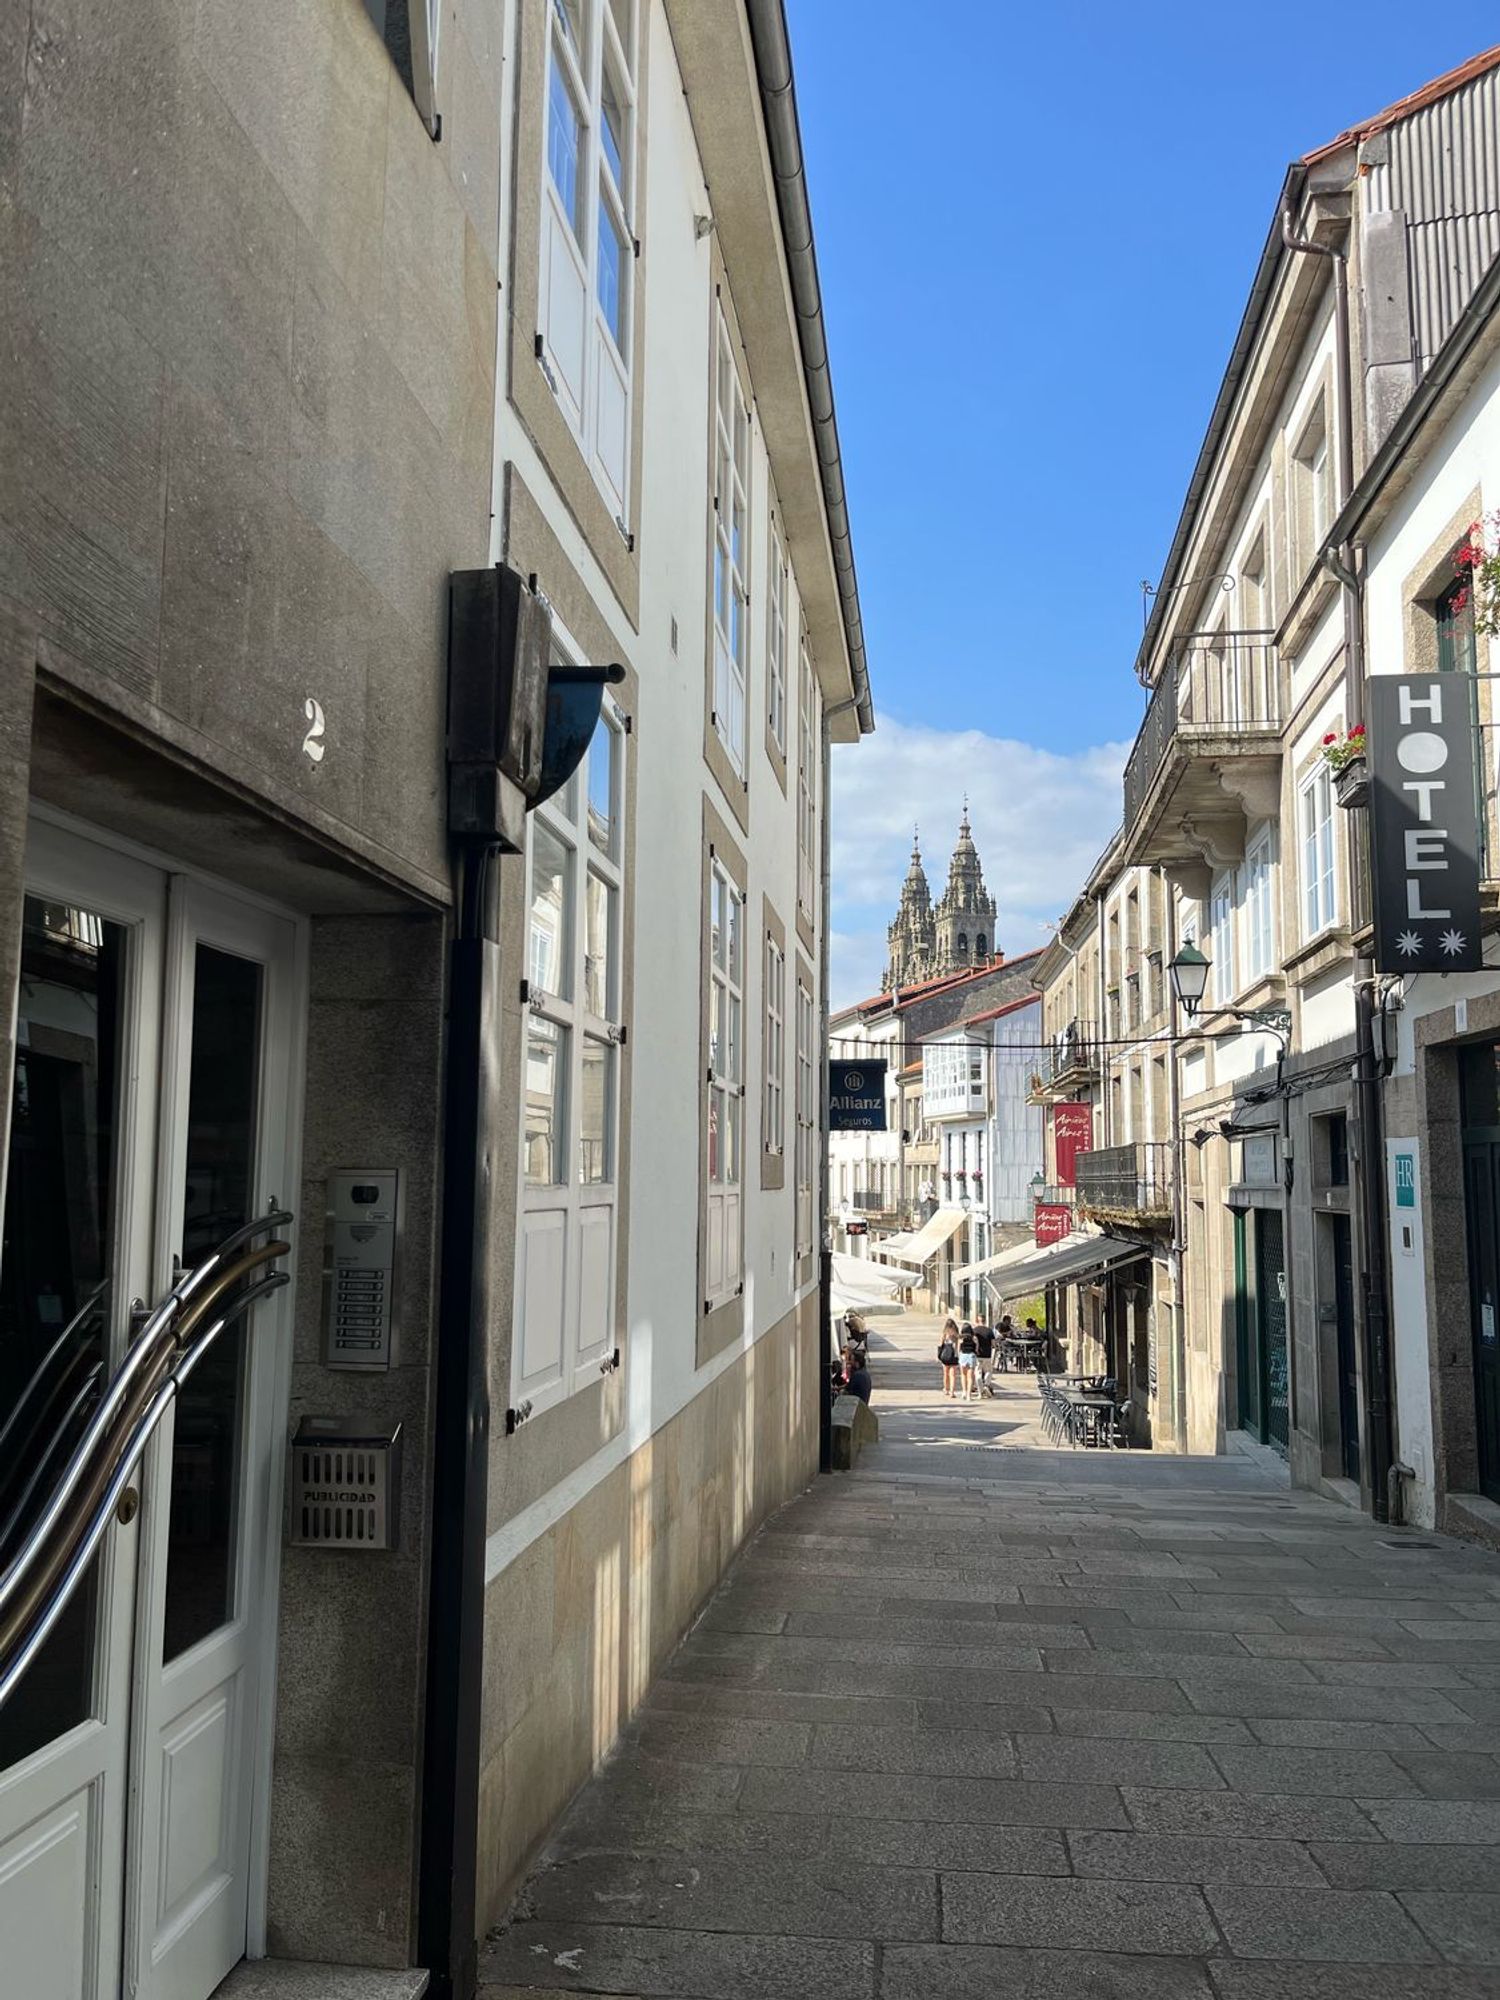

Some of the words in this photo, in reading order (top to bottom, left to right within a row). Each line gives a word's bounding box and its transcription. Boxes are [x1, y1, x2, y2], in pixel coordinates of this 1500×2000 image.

[302, 697, 325, 762] 2
[1397, 684, 1451, 919] HOTEL
[830, 1096, 882, 1109] Allianz
[838, 1116, 872, 1128] Seguros
[1396, 1160, 1414, 1187] HR
[304, 1491, 376, 1502] PUBLICIDAD
